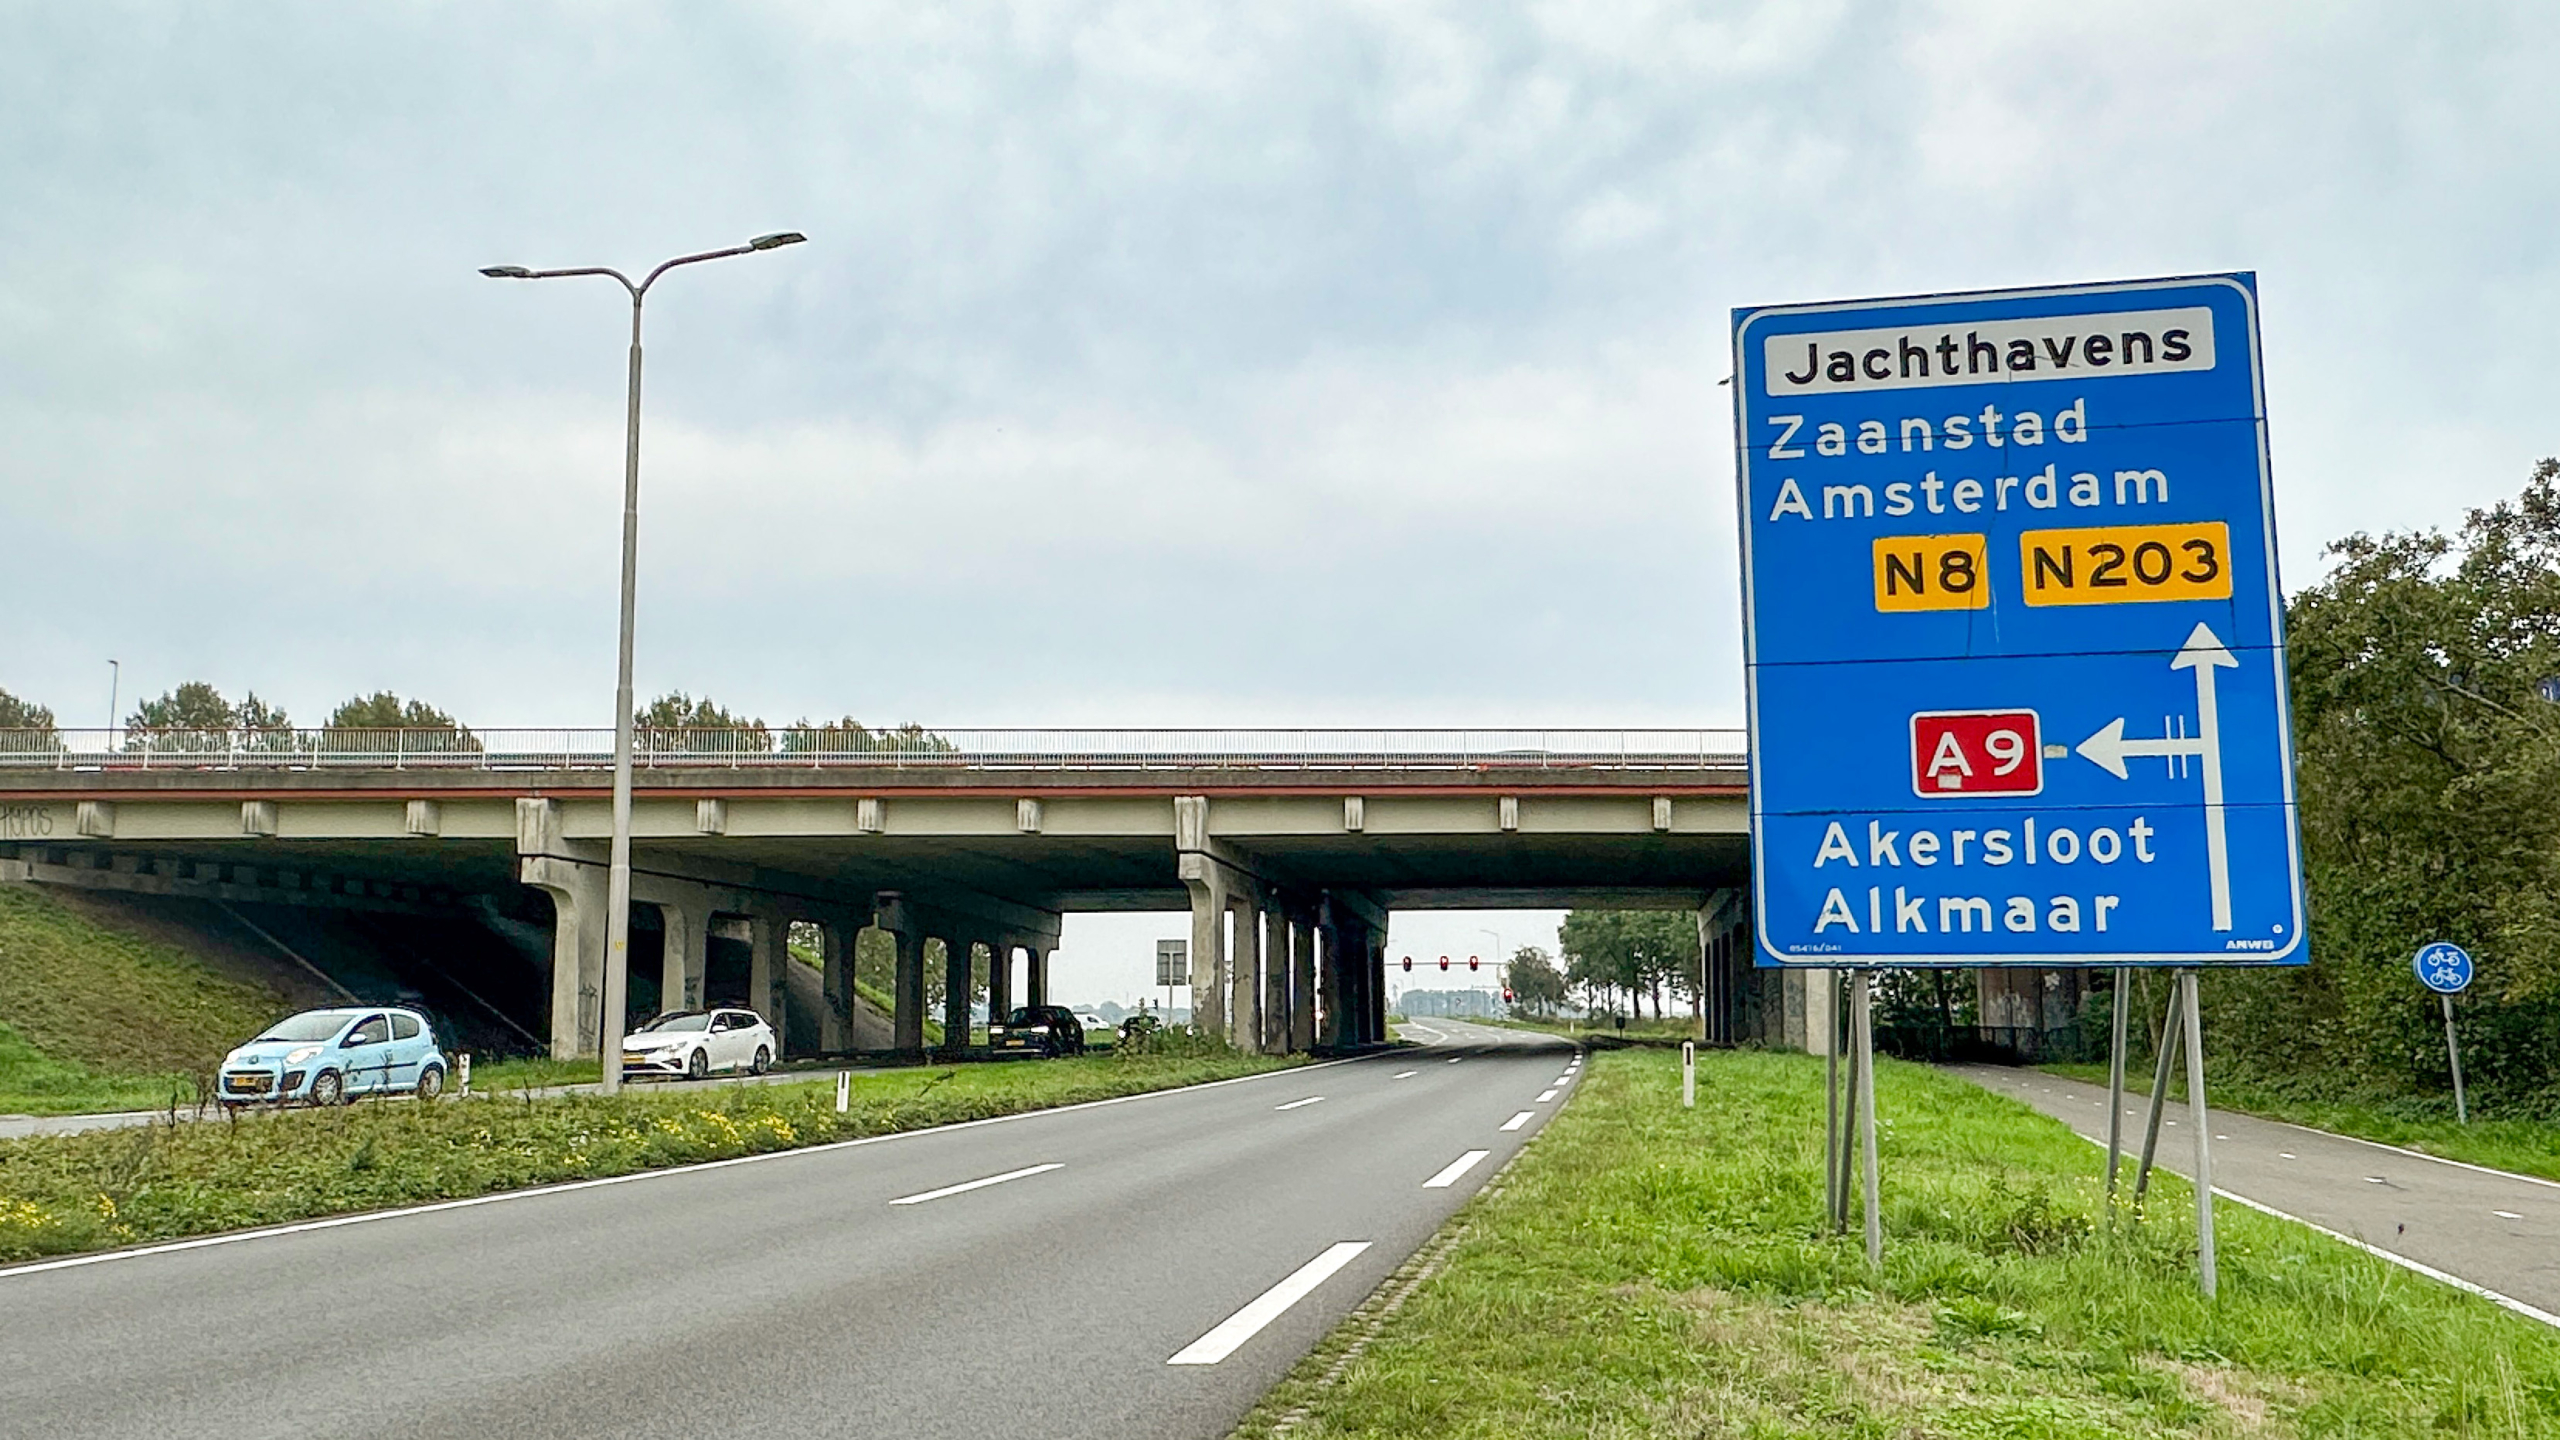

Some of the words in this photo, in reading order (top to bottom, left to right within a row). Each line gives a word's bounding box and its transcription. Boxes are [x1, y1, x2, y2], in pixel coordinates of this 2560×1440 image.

[1785, 329, 2192, 386] Jachthavens
[1768, 398, 2087, 459] Zaanstad
[1770, 464, 2169, 522] Amsterdam
[1885, 550, 1977, 596] N8
[2033, 539, 2219, 590] N203
[1814, 817, 2156, 868] Akersloot
[1814, 887, 2120, 934] Alkmaar
[2225, 939, 2275, 950] ANWB
